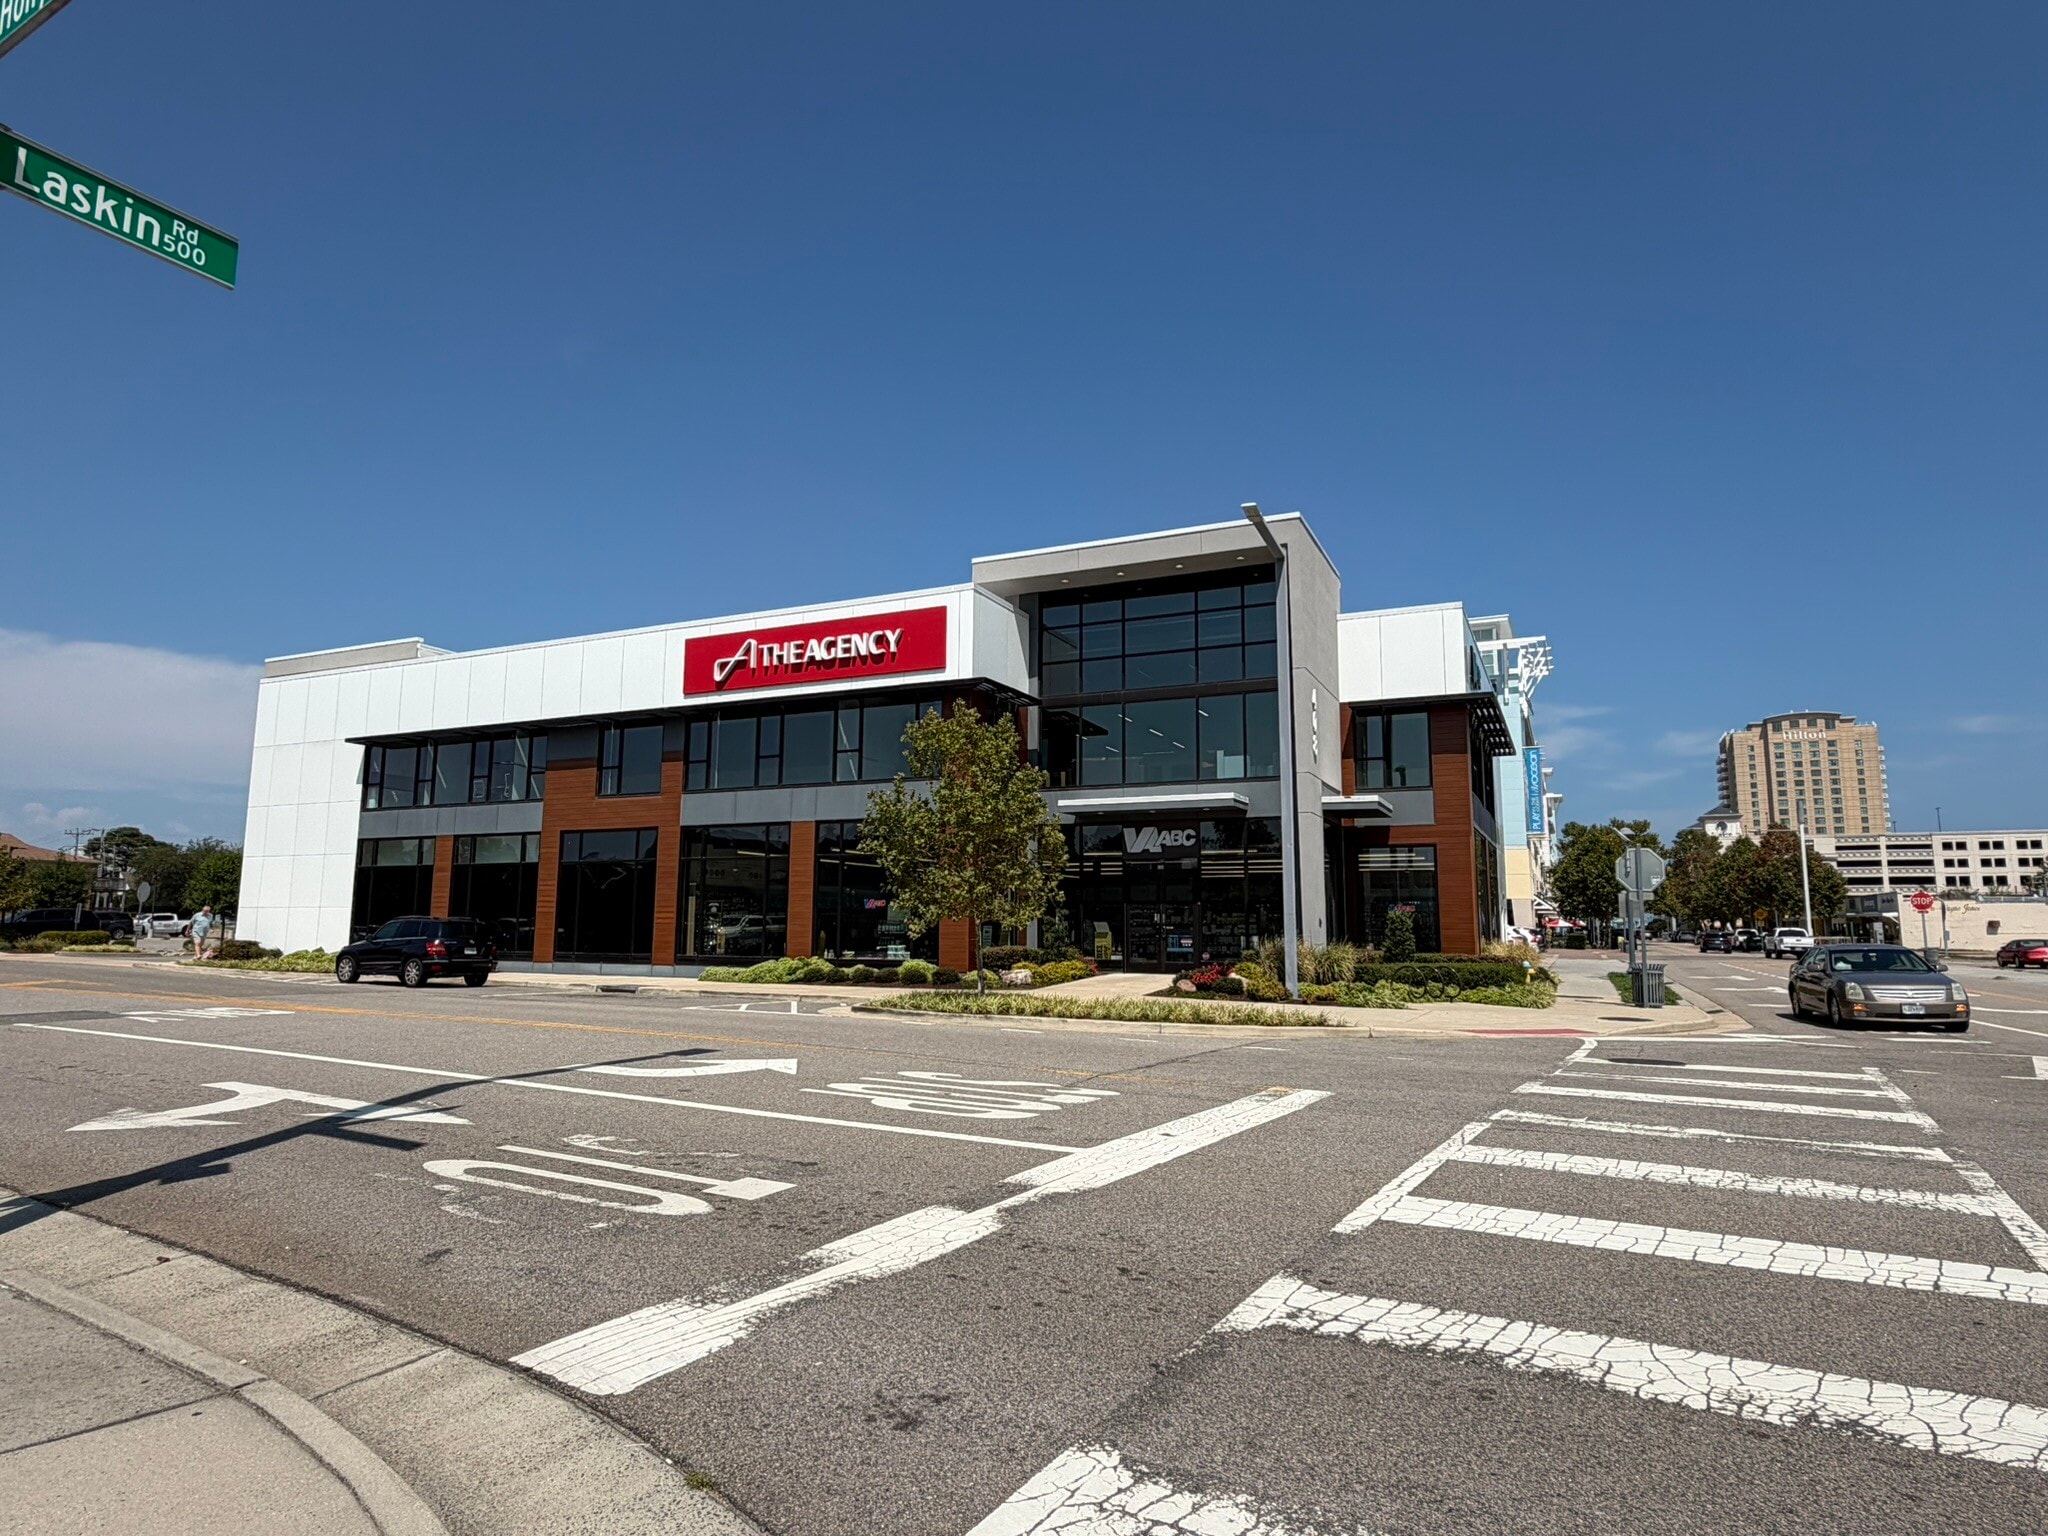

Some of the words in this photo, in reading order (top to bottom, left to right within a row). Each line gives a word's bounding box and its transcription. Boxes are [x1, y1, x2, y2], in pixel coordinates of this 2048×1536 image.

[15, 147, 161, 247] Laskin
[172, 219, 199, 245] Rd
[163, 234, 206, 266] 500
[1782, 730, 1827, 740] Hilton
[1156, 828, 1197, 848] ABC
[1912, 897, 1932, 905] STOP
